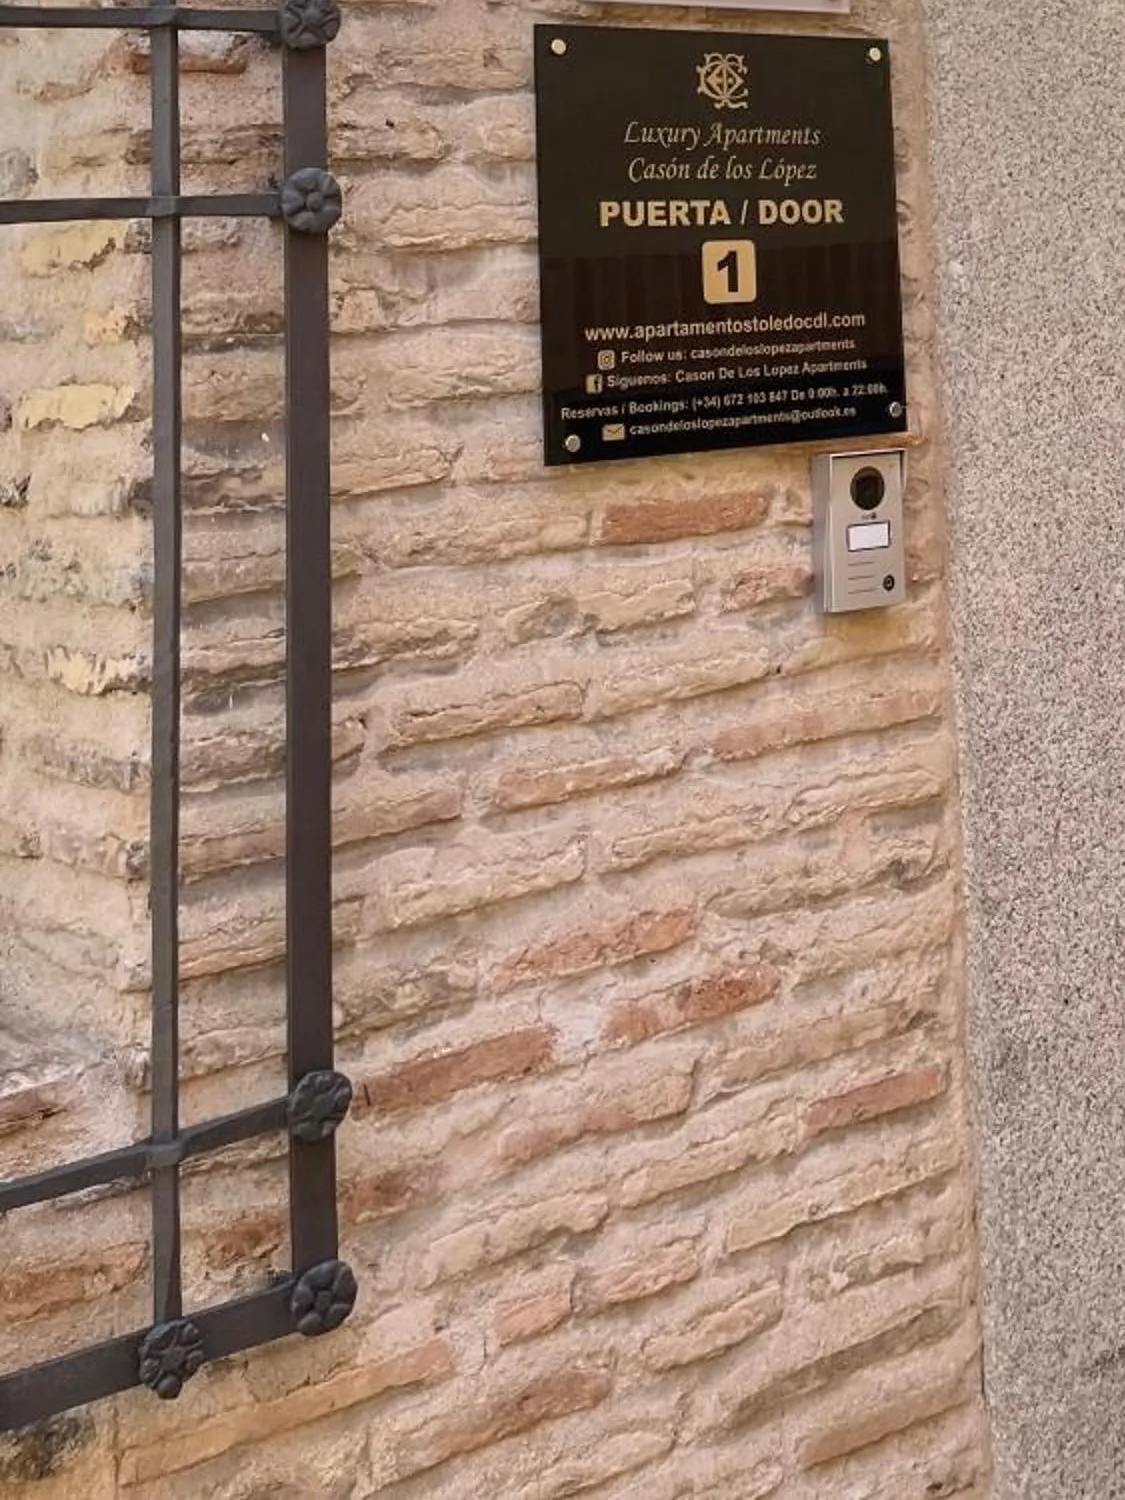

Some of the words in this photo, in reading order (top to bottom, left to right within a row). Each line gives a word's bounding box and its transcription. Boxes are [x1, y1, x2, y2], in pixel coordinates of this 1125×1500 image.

[624, 121, 701, 151] Luxury
[703, 122, 821, 151] Apartments
[628, 156, 691, 183] Casón
[696, 155, 720, 180] de
[725, 155, 753, 180] los
[758, 157, 818, 187] López
[600, 200, 731, 227] PUERTA
[739, 199, 749, 225] /
[758, 199, 845, 225] DOOR
[717, 250, 739, 292] 1
[584, 312, 866, 343] www.apartamentostoledocdl.com
[621, 350, 665, 363] Follow
[668, 351, 688, 362] us:
[719, 367, 735, 379] De
[738, 365, 761, 379] Los
[802, 359, 868, 376] Apartments
[561, 405, 619, 420] Reservas
[629, 400, 689, 414] Bookings:
